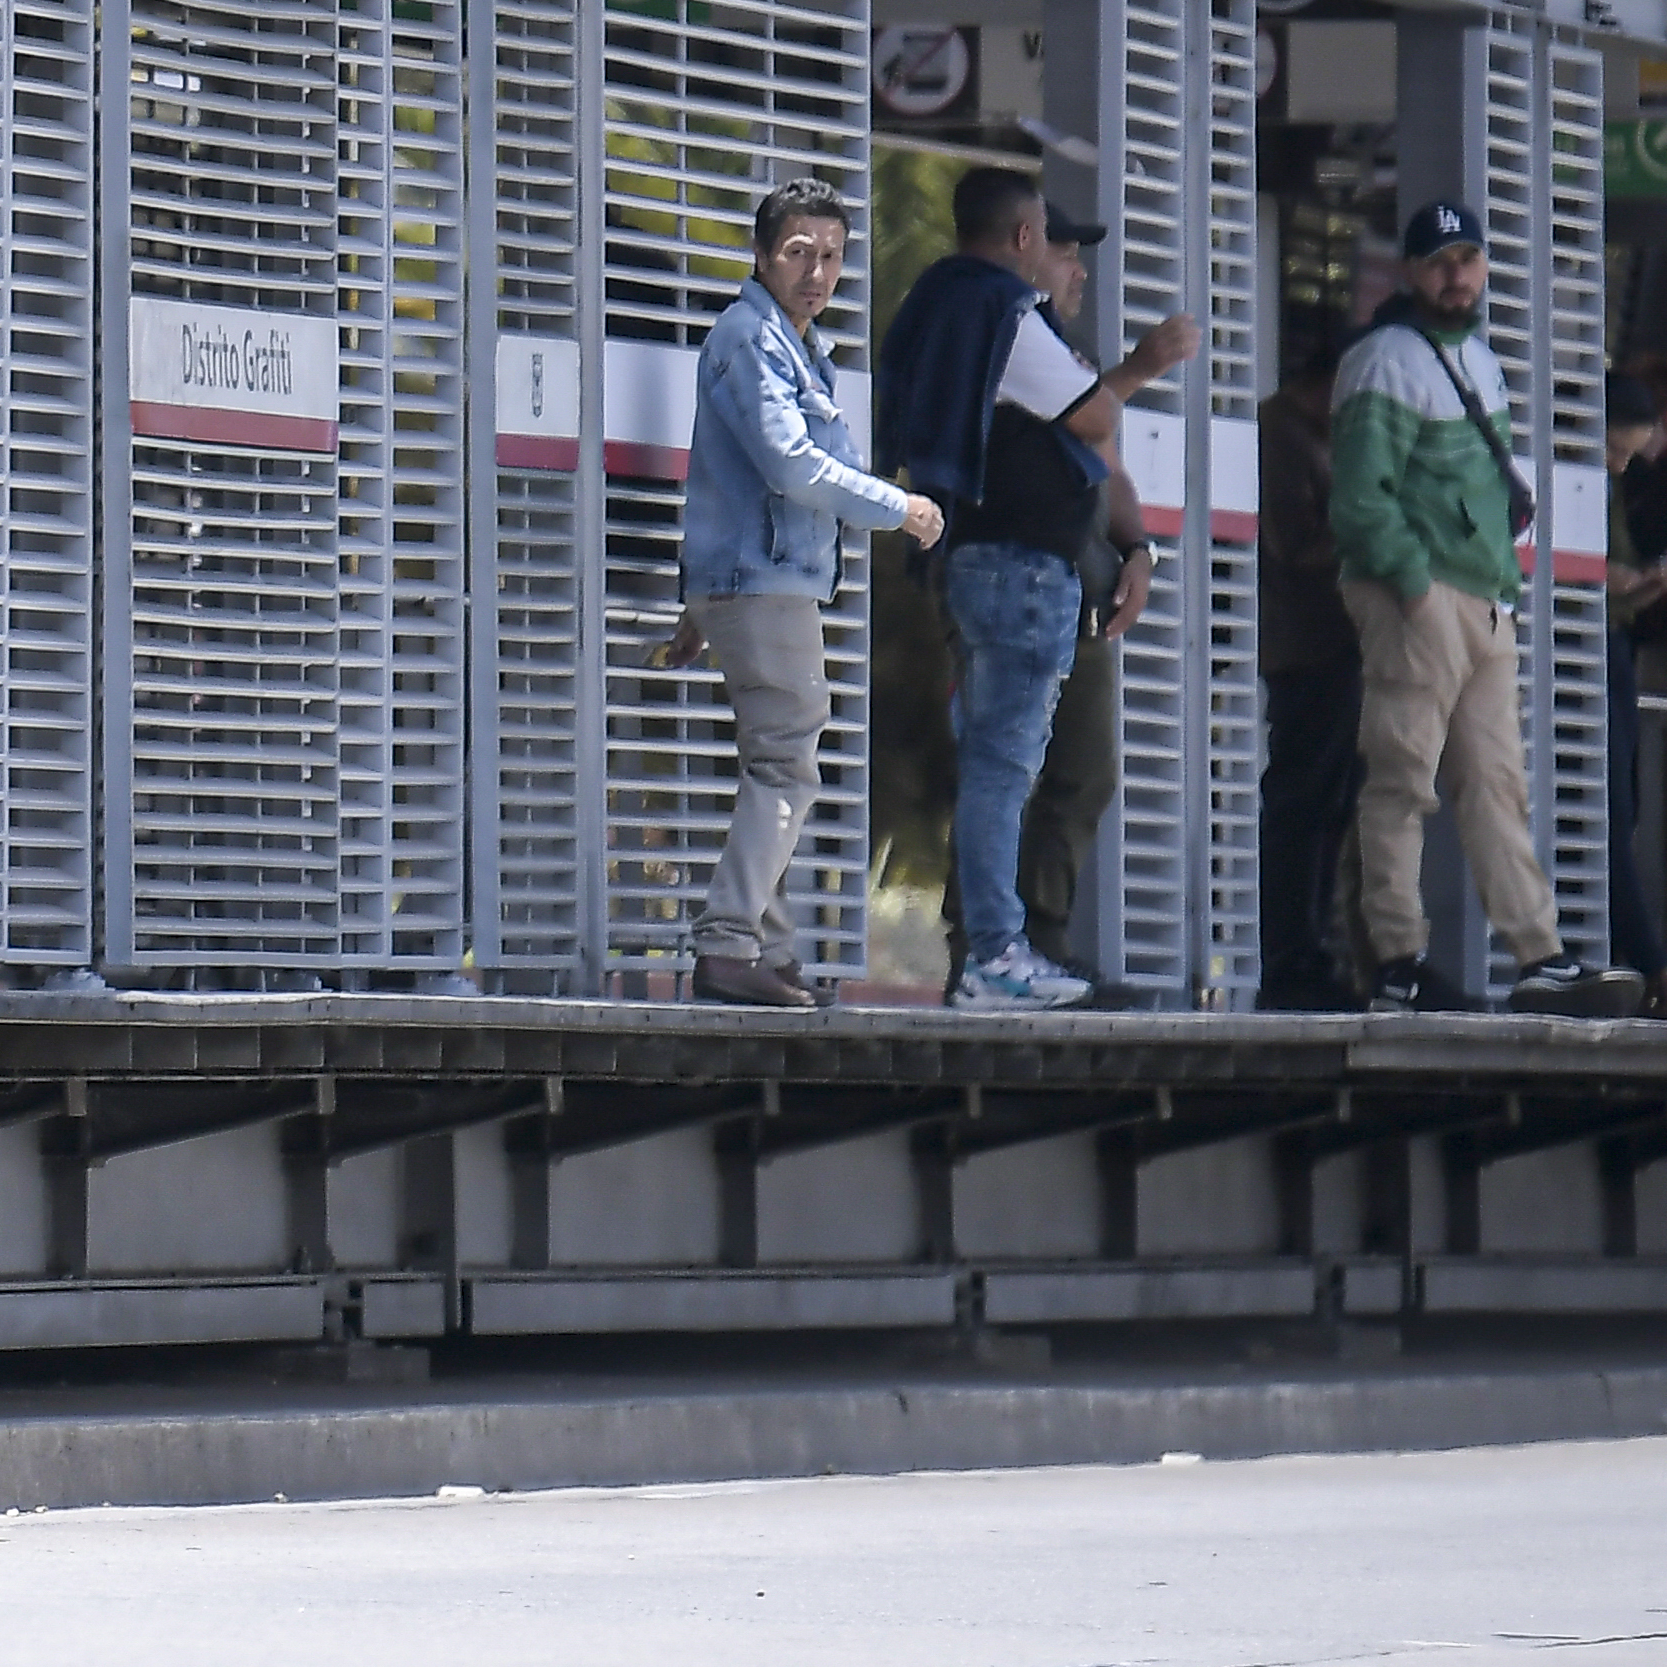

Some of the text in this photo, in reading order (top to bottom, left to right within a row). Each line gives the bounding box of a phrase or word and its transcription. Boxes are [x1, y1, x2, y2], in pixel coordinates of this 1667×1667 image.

[1437, 204, 1463, 233] LA
[180, 321, 294, 395] Distrito Grafiti
